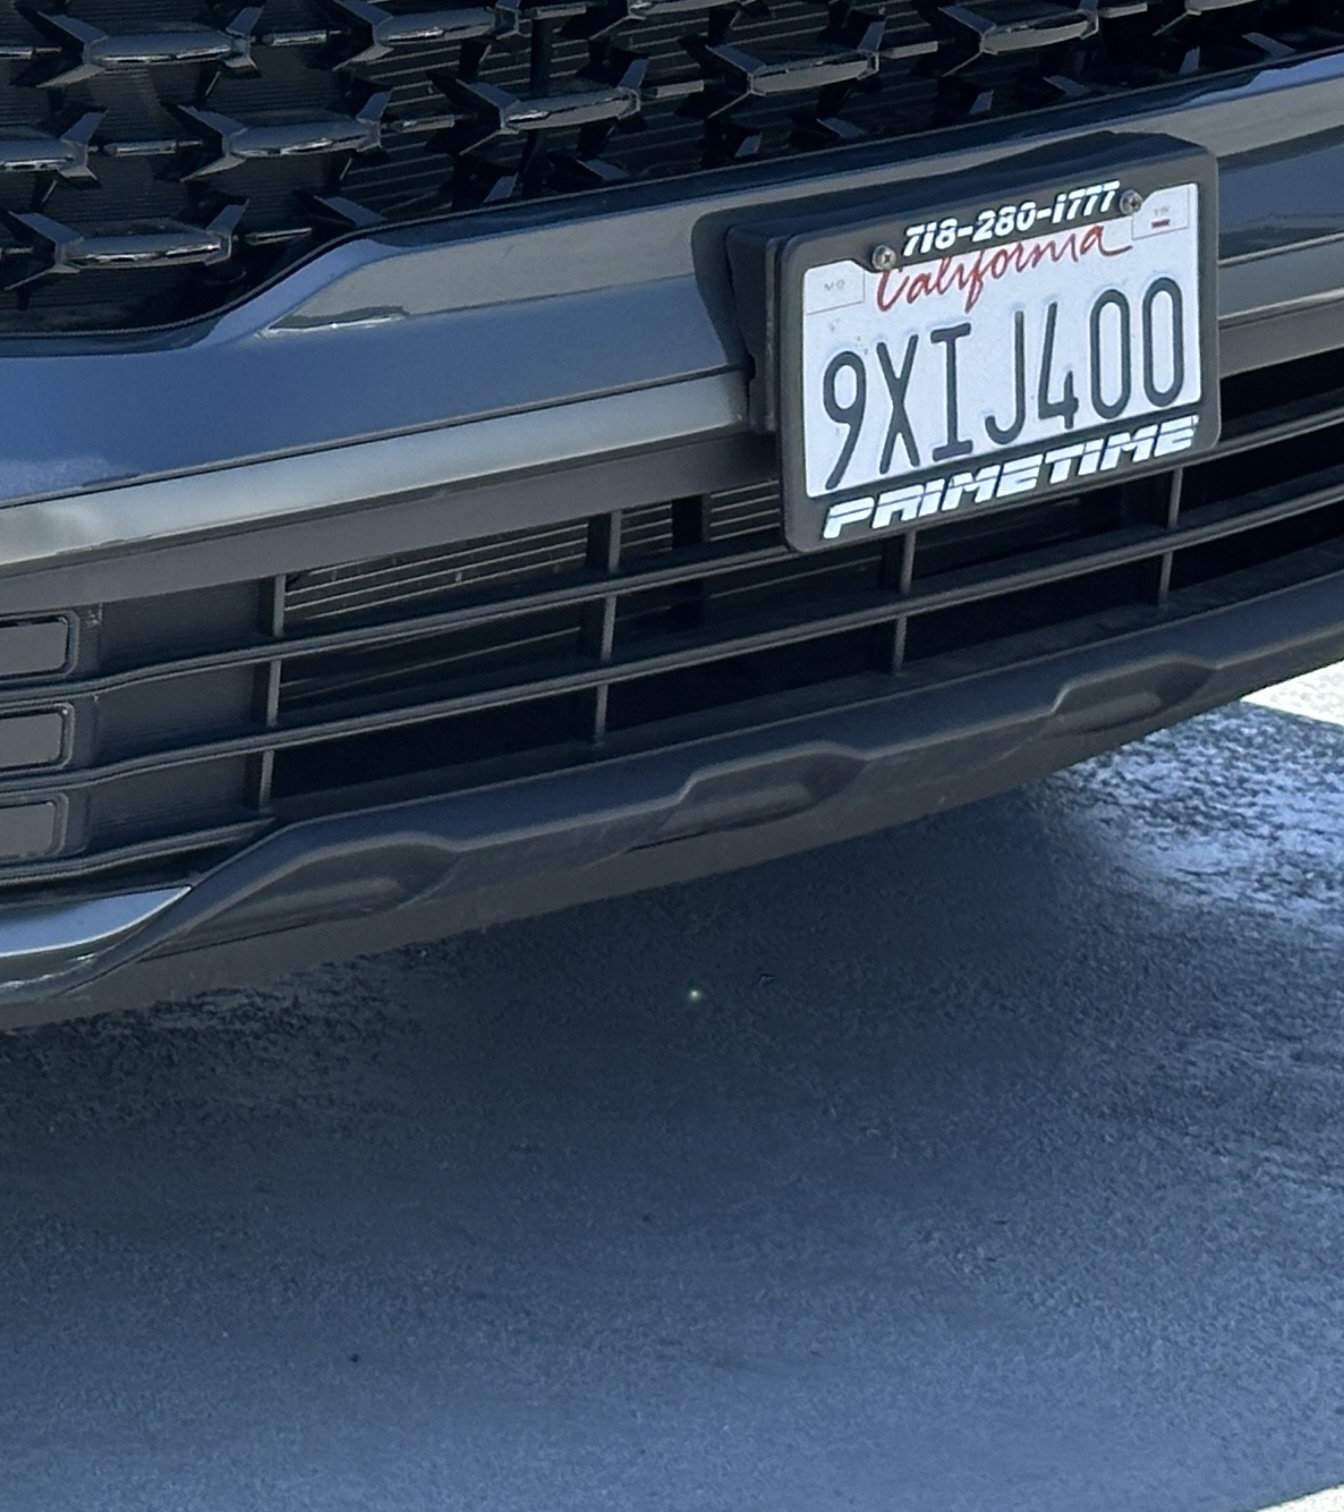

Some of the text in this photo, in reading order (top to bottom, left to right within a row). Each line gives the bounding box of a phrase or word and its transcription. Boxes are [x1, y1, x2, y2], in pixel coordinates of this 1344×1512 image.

[876, 223, 1133, 313] California
[902, 180, 1121, 257] 718-280-1777
[822, 276, 1185, 491] 9XIJ400
[822, 414, 1200, 541] PRIMETIME
